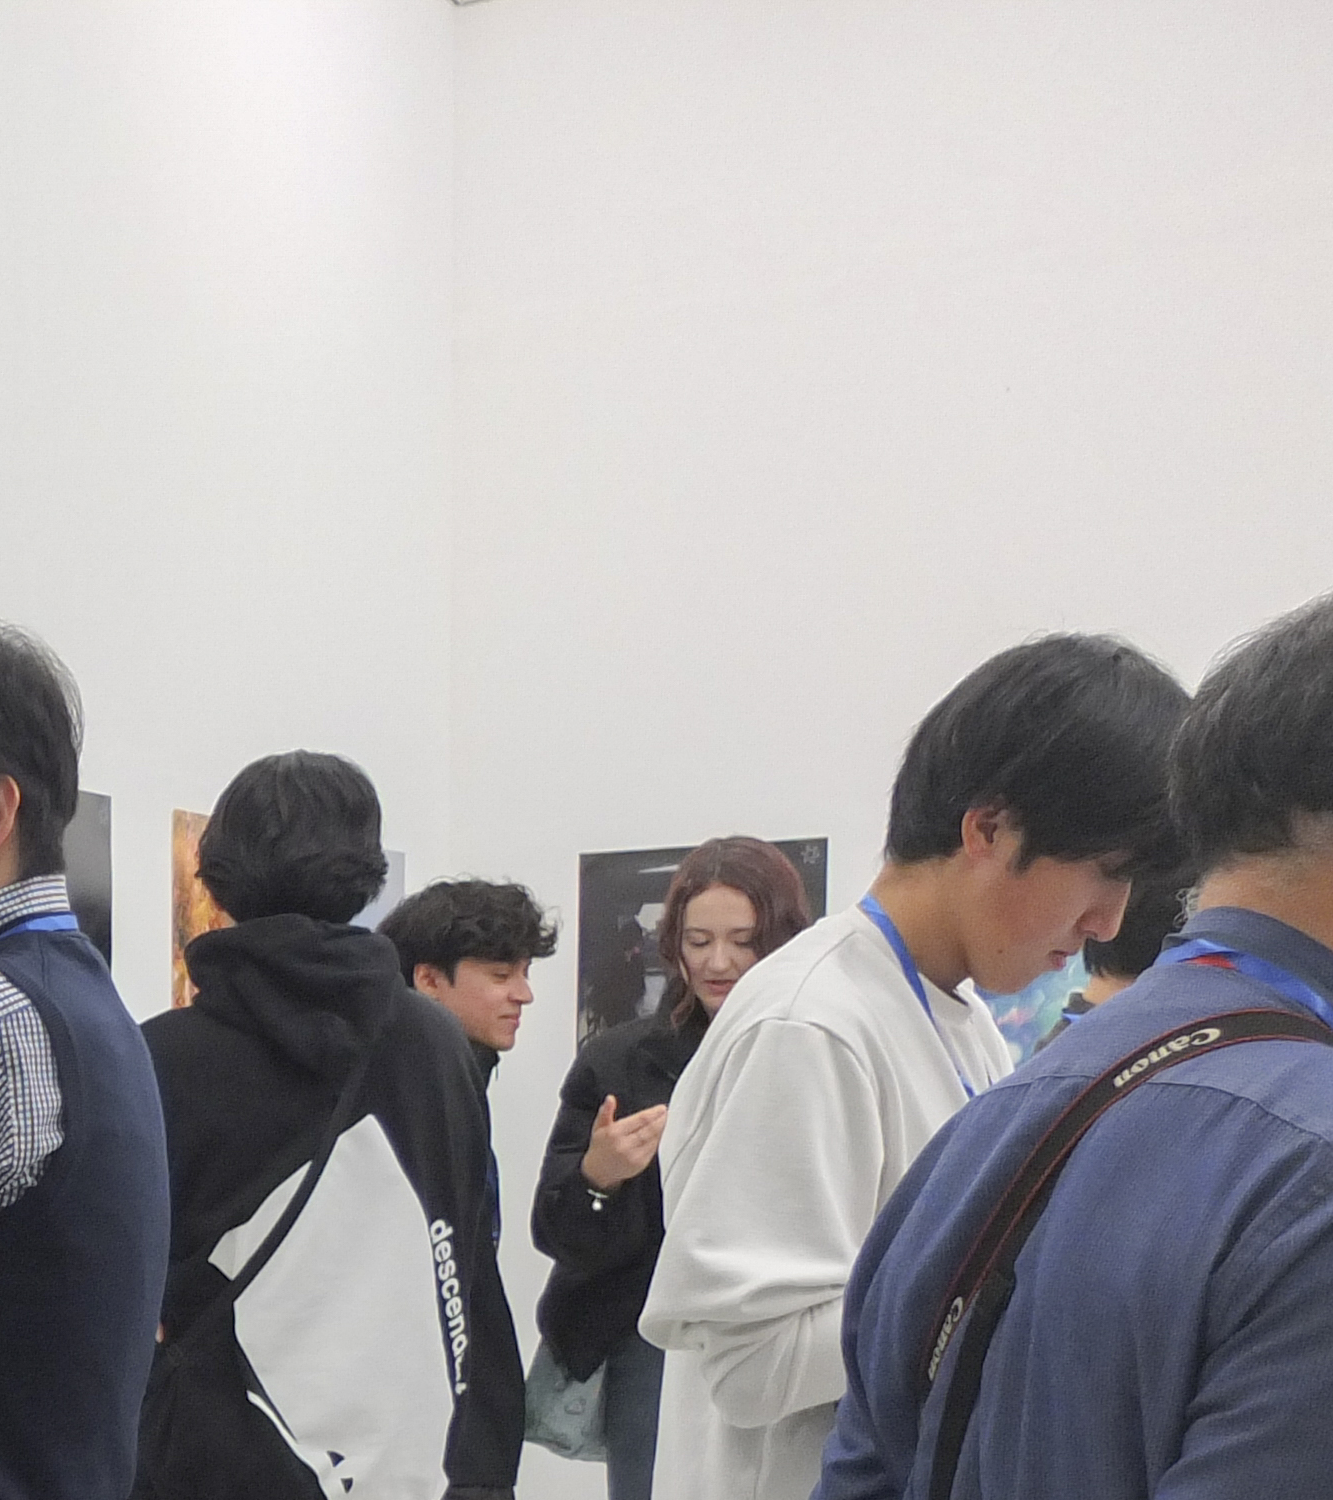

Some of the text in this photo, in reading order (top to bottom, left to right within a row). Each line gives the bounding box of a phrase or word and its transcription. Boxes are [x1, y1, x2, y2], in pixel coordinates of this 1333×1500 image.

[1113, 1027, 1222, 1088] Canon
[430, 1218, 469, 1395] descend
[928, 1296, 964, 1381] Canon
